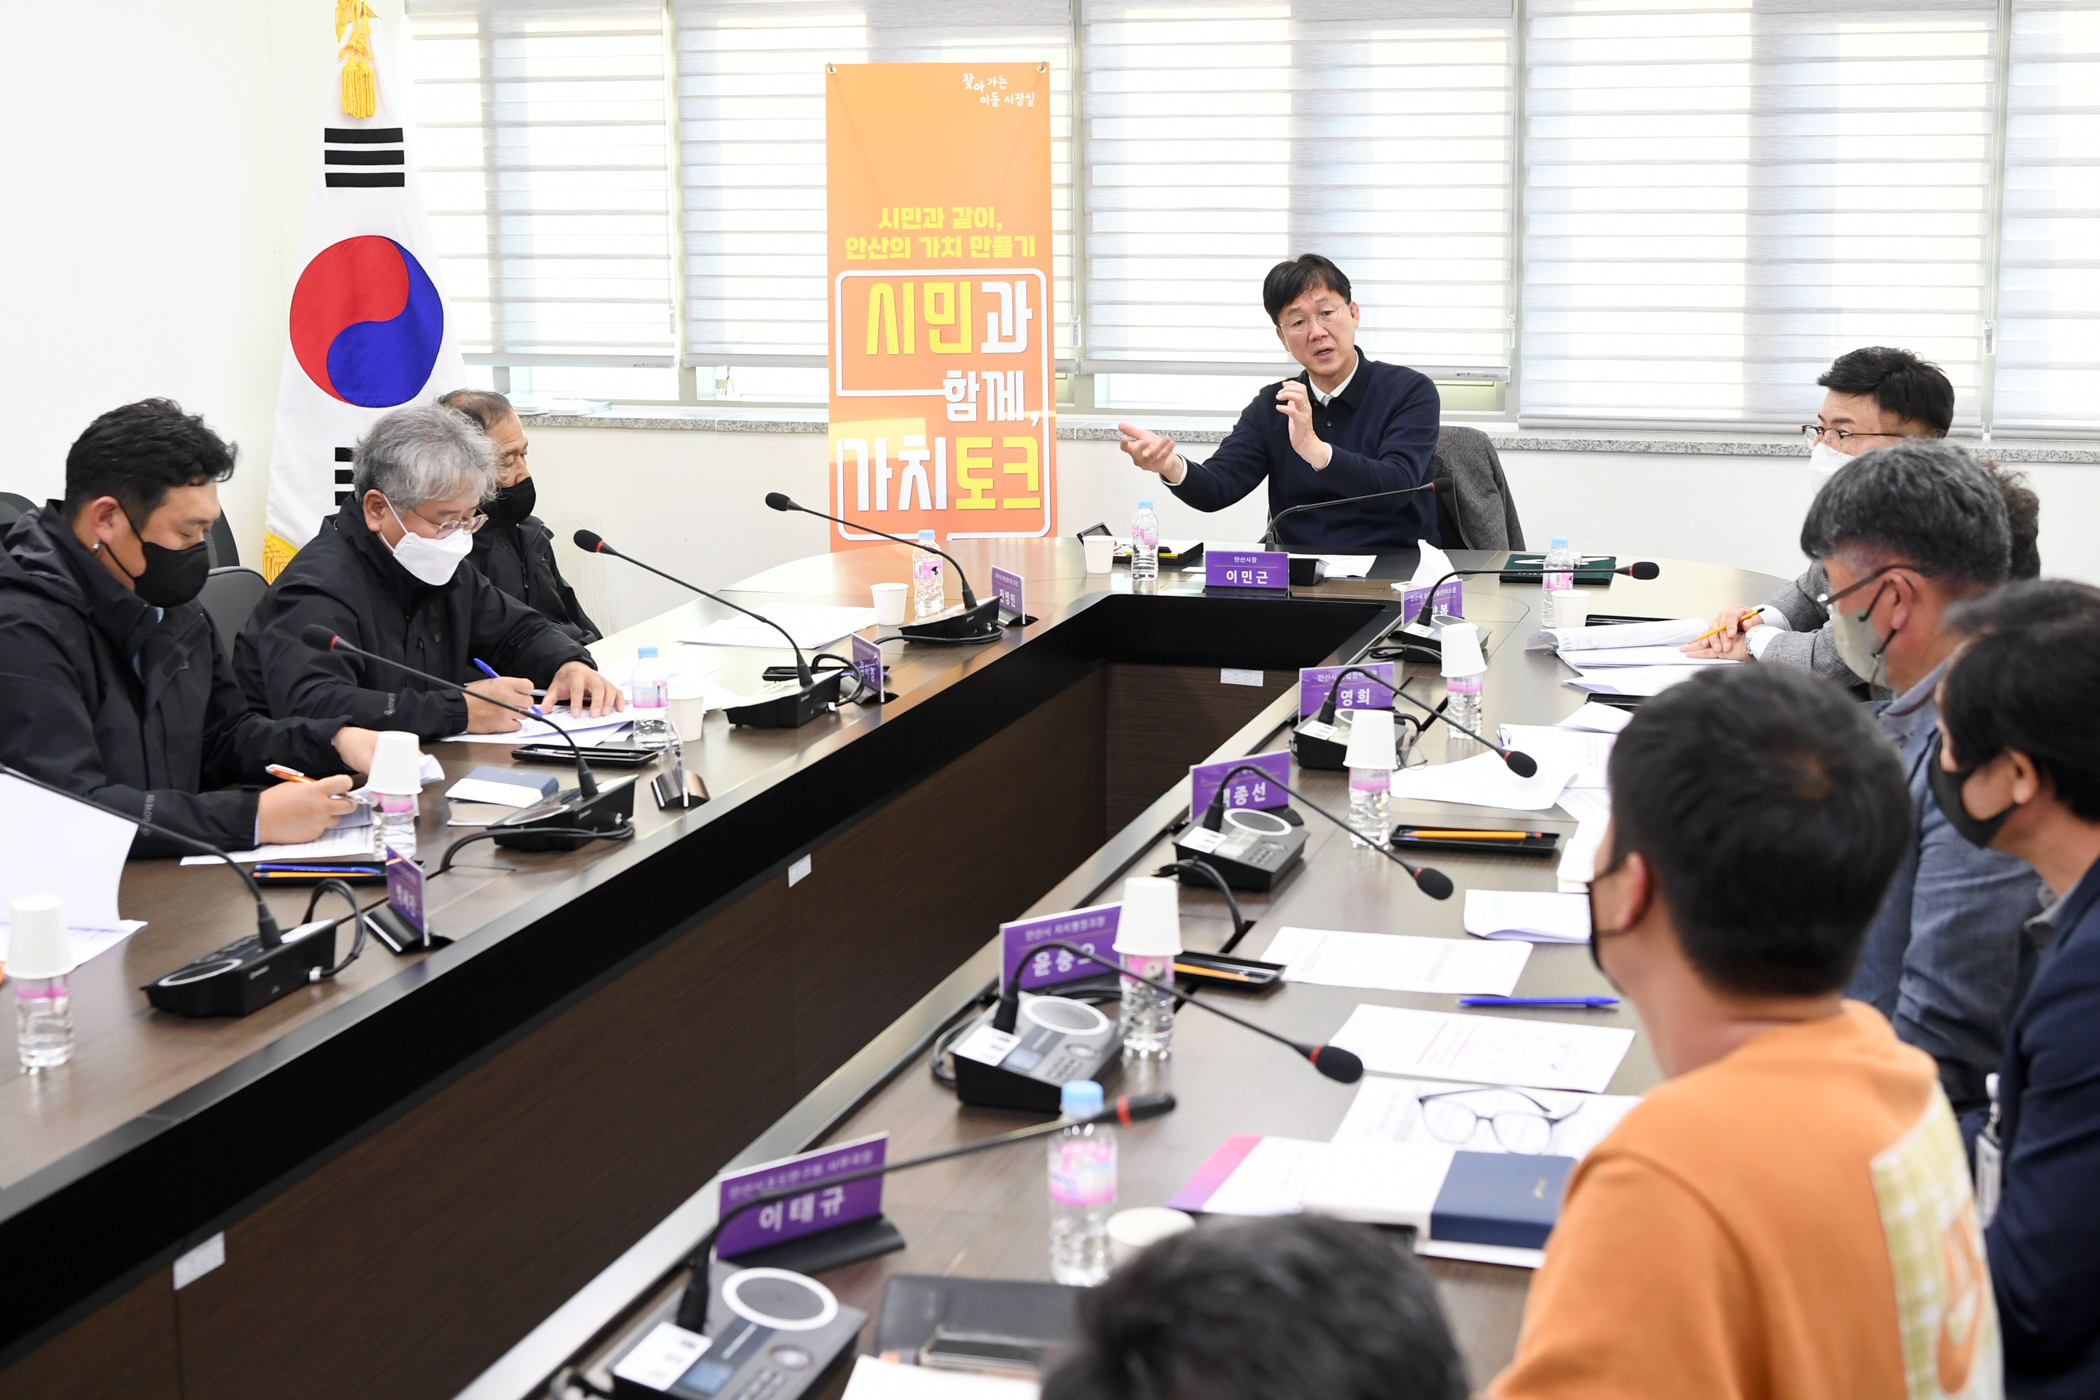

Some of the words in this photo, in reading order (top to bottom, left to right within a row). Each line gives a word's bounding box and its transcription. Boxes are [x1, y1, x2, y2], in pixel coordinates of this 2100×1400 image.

[980, 92, 1000, 107] 이동
[1004, 92, 1035, 107] 시장실
[878, 207, 945, 230] 시민과
[952, 206, 1003, 231] 같이,
[845, 237, 911, 260] 안산의
[919, 236, 962, 259] 가치
[970, 235, 1035, 259] 만들기
[866, 281, 1033, 355] 시민과
[942, 370, 1040, 427] 함께,
[843, 435, 1041, 511] 가치토크
[1226, 570, 1269, 584] 이민근
[1317, 672, 1337, 682] 안산시
[1324, 688, 1370, 708] 영희
